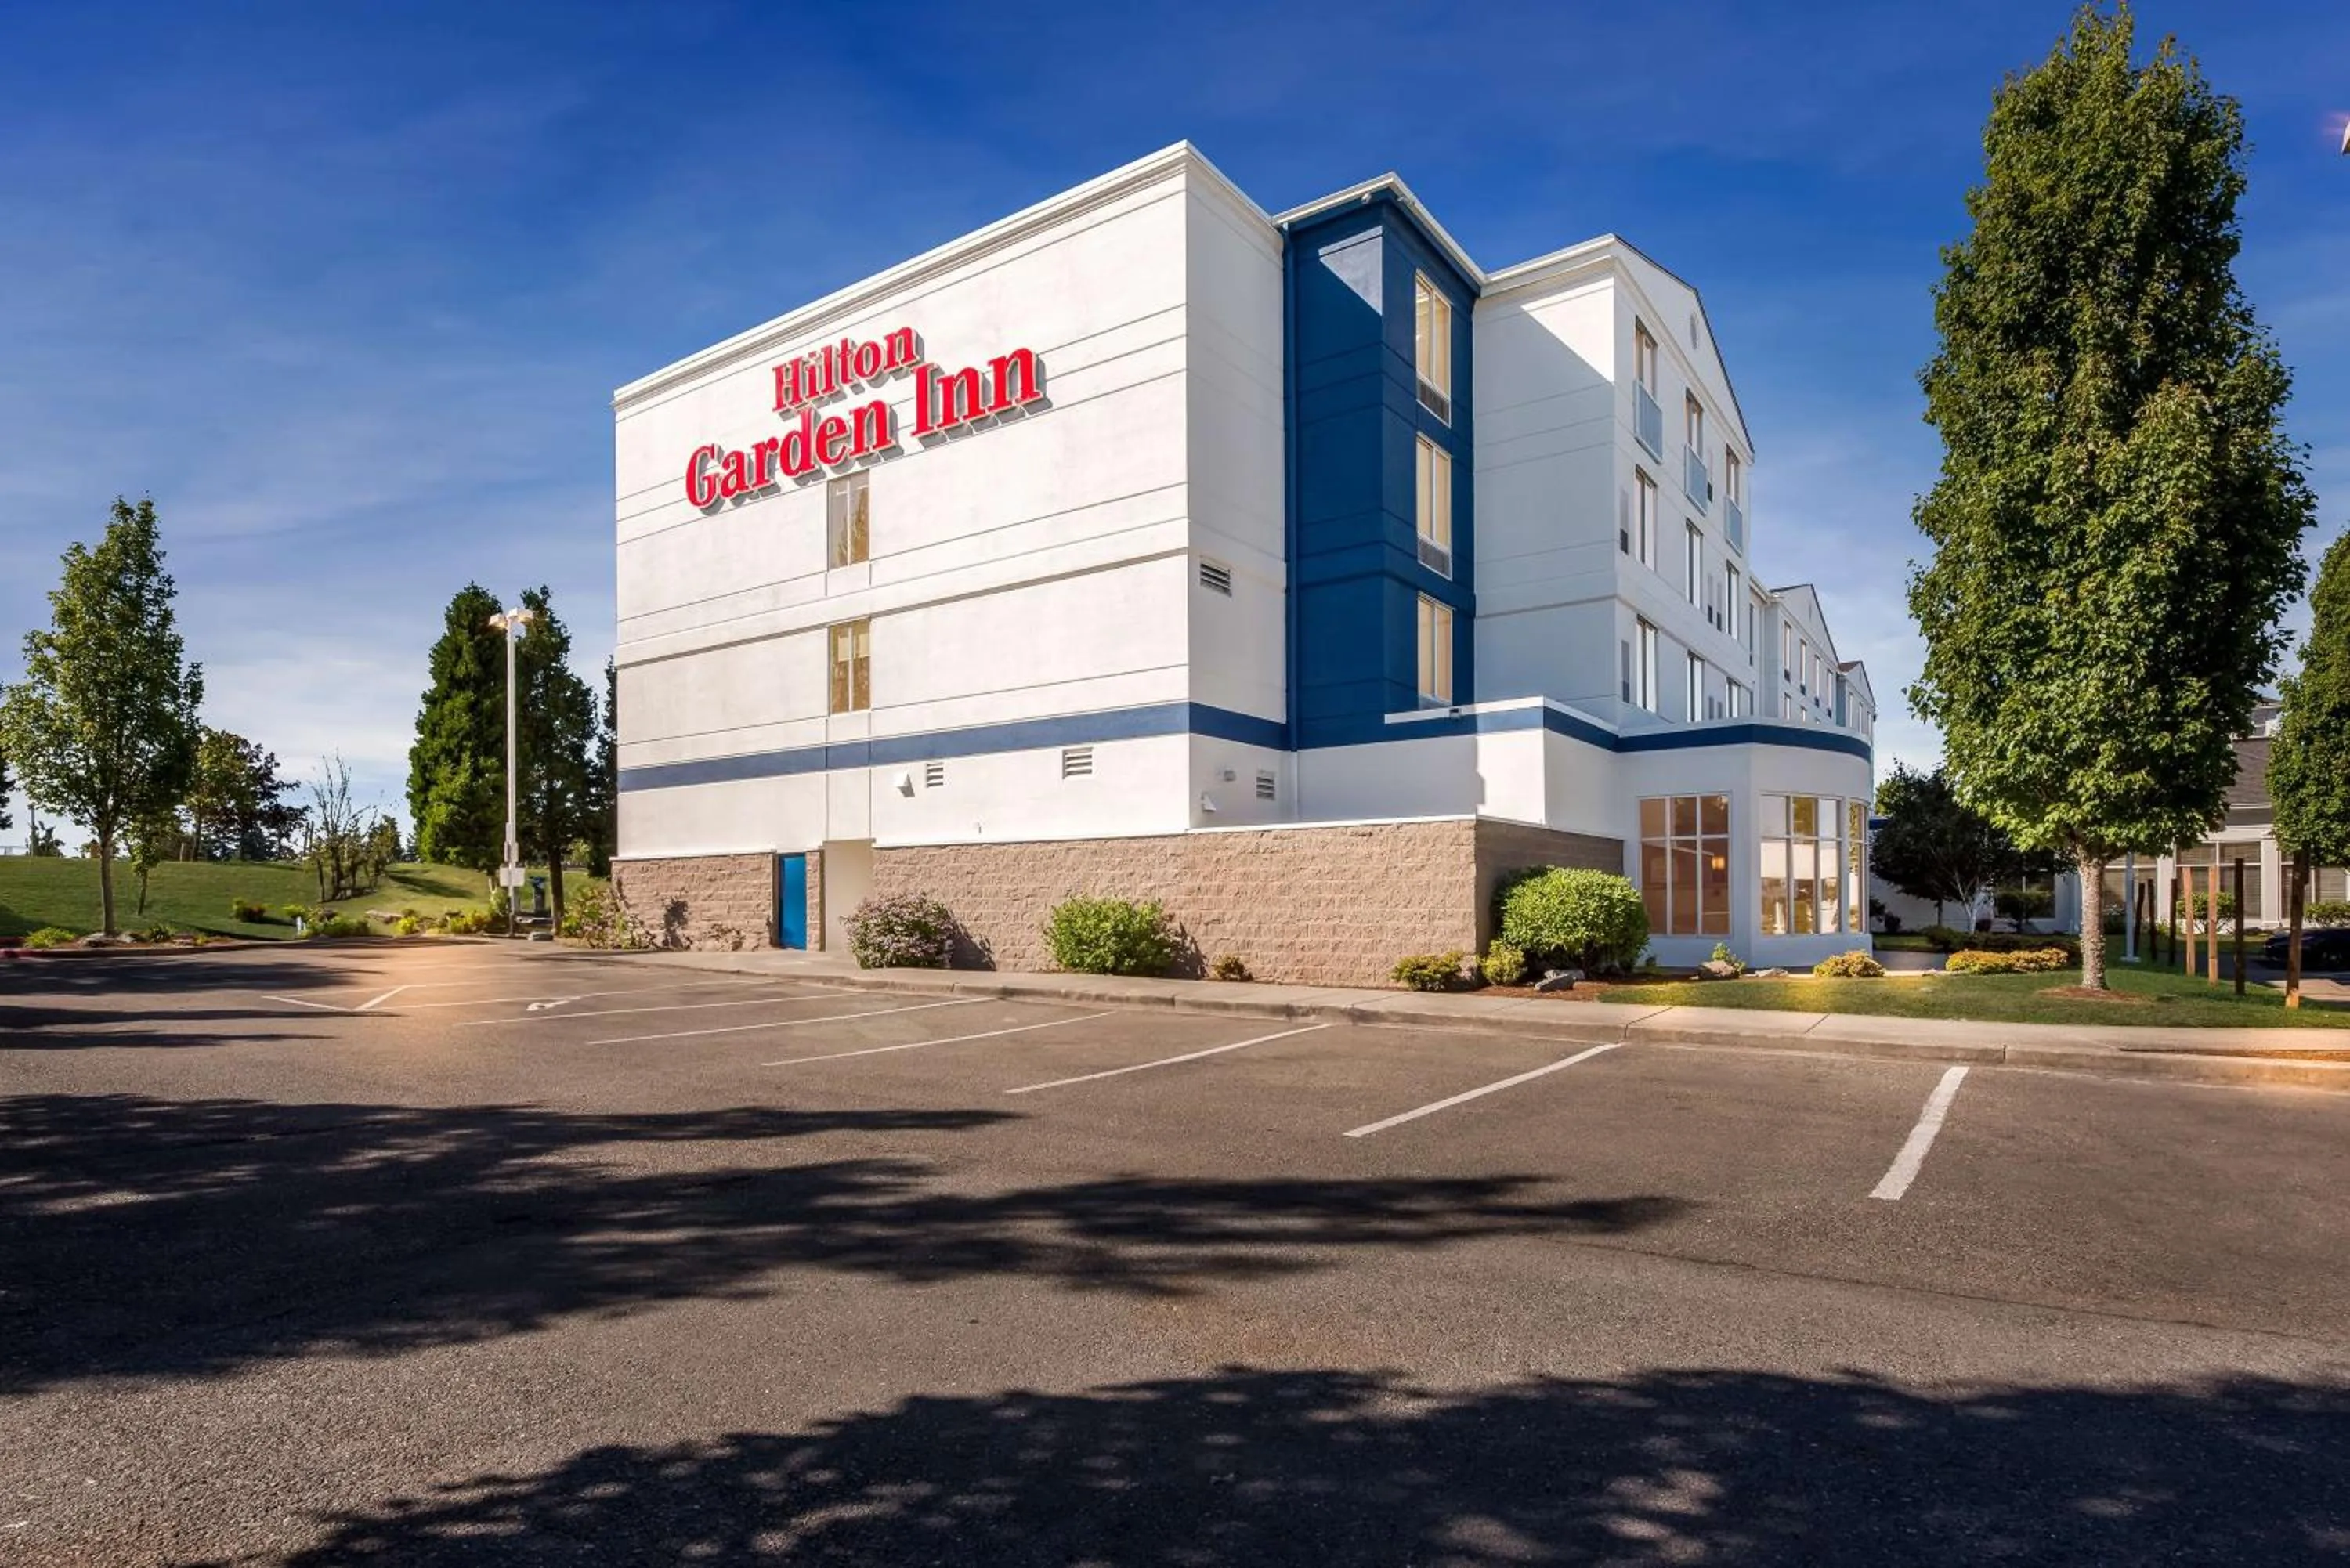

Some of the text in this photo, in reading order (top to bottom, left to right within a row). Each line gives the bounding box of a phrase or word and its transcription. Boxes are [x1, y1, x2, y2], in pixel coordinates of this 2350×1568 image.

[685, 347, 1040, 508] Garden Inn
[772, 326, 917, 413] Hilton
